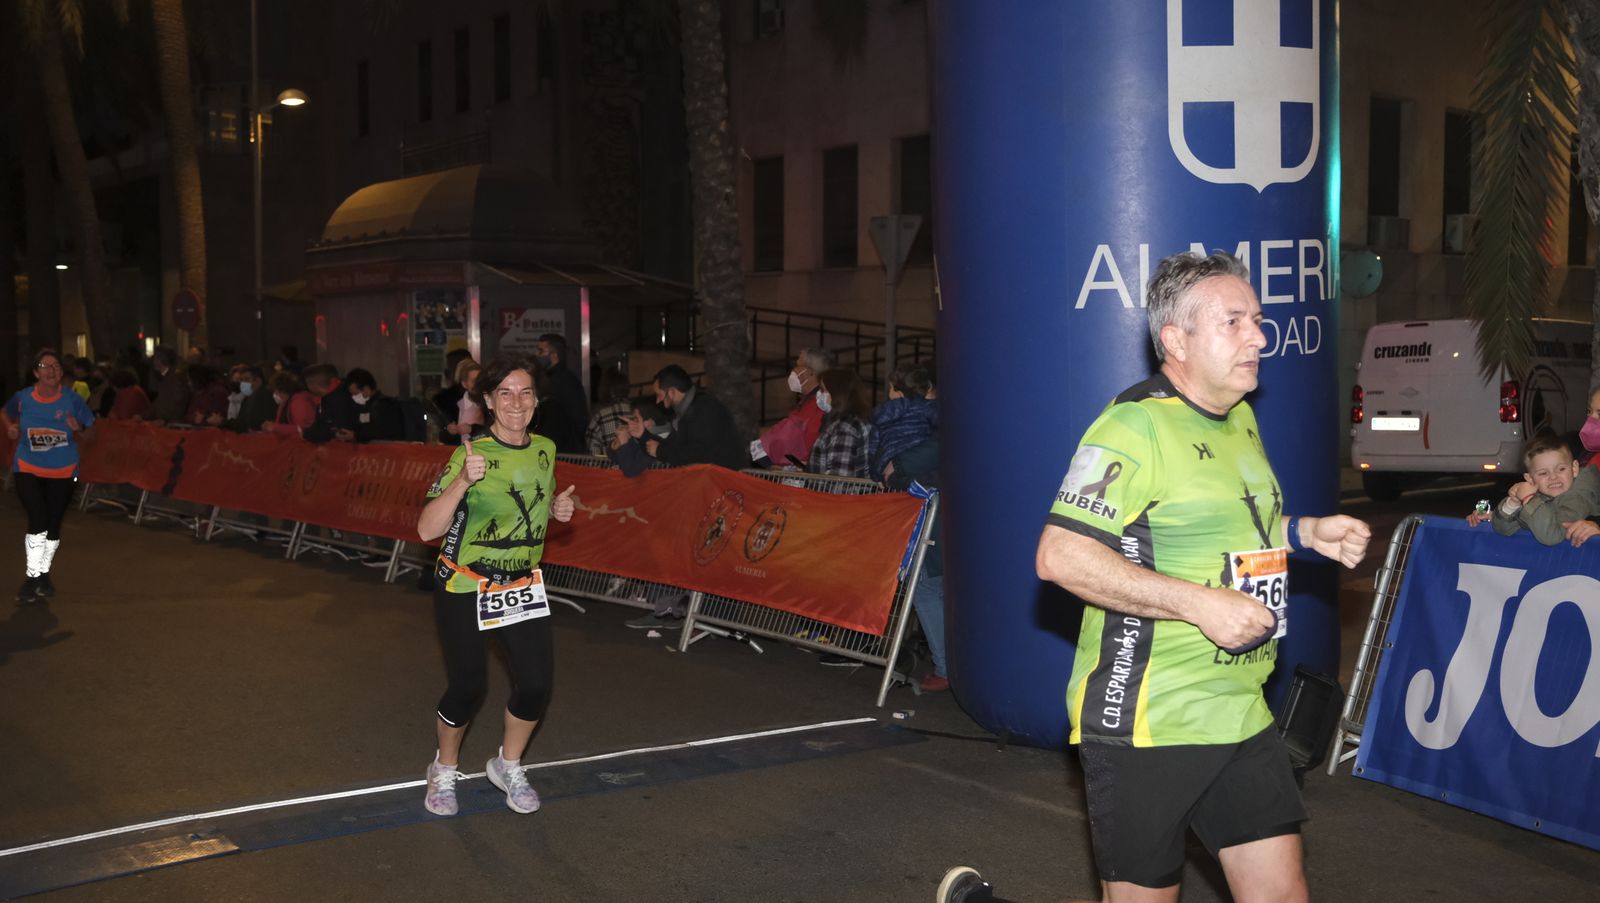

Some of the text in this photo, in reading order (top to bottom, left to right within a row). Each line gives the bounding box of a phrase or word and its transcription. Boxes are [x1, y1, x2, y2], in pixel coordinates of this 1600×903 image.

[1056, 490, 1117, 520] RUBÉN
[490, 587, 535, 611] 565
[1404, 562, 1600, 759] JO
[1102, 705, 1122, 729] C.D.
